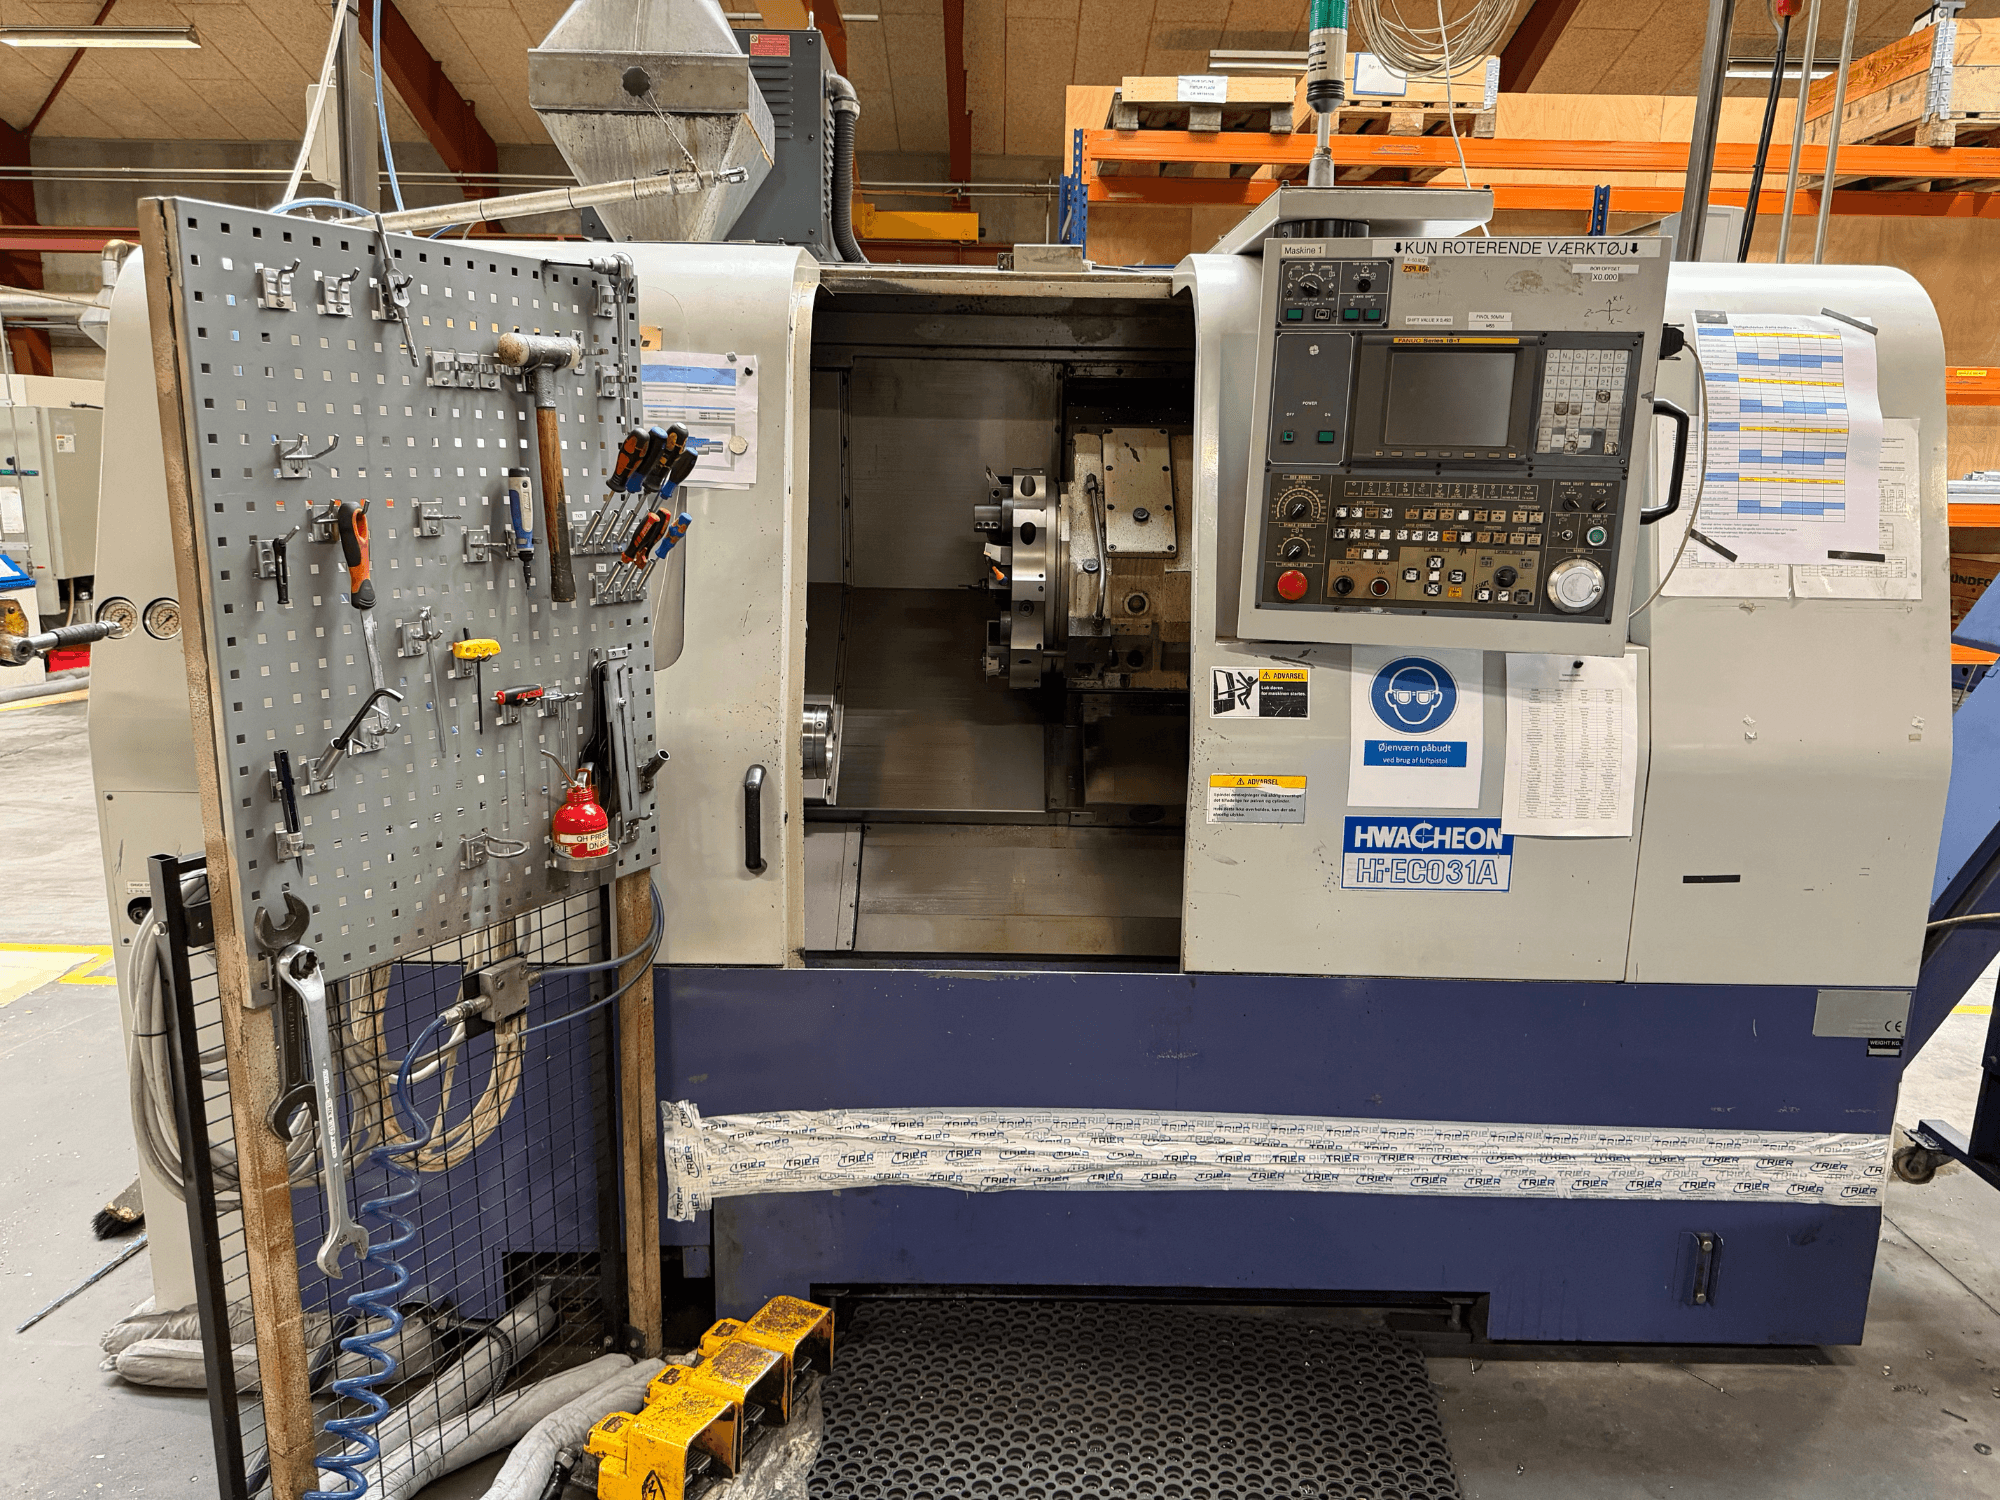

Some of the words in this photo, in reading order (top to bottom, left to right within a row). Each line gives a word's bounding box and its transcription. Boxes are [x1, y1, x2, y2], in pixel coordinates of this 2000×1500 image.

[1285, 247, 1316, 255] Maskine
[1405, 241, 1438, 254] KUN
[1443, 241, 1542, 255] ROTERENDE
[1548, 241, 1628, 255] VÆRKTØJ
[1593, 273, 1618, 281] X0.000
[1273, 672, 1305, 680] ADVARSEL
[1378, 742, 1420, 754] Øjenværn
[1421, 742, 1452, 754] påbudt
[1382, 756, 1394, 764] ved
[1396, 756, 1411, 765] brug
[1411, 756, 1419, 764] af
[1419, 756, 1448, 765] luftpistol
[1354, 821, 1503, 850] HWACHEON
[1162, 1123, 1195, 1133] TRIER
[1217, 1124, 1250, 1134] TRIER
[1271, 1126, 1305, 1136] TRIER
[1327, 1128, 1360, 1138] TRIER
[1382, 1130, 1415, 1140] TRIER
[1437, 1132, 1470, 1142] TRIER
[1491, 1134, 1525, 1144] TRIER
[1546, 1136, 1579, 1145] TRIER
[1600, 1138, 1633, 1147] TRIER
[1709, 1141, 1742, 1151] TRIER
[841, 1153, 874, 1164] TRIER
[894, 1150, 927, 1160] TRIER
[950, 1149, 982, 1158] TRIER
[1326, 1153, 1360, 1163] TRIER
[1381, 1153, 1415, 1162] TRIER
[787, 1157, 820, 1169] TRIER
[1218, 1154, 1251, 1164] TRIER
[1272, 1154, 1306, 1164] TRIER
[1761, 1157, 1794, 1168] TRIER
[1815, 1161, 1848, 1172] TRIER
[984, 1175, 1017, 1185] TRIER
[1251, 1171, 1285, 1181] TRIER
[1306, 1172, 1340, 1182] TRIER
[1360, 1174, 1394, 1184] TRIER
[1414, 1175, 1448, 1185] TRIER
[1469, 1176, 1502, 1186] TRIER
[1522, 1177, 1556, 1188] TRIER
[1576, 1178, 1609, 1189] TRIER
[1630, 1179, 1663, 1189] TRIER
[1683, 1180, 1716, 1190] TRIER
[1737, 1181, 1770, 1191] TRIER
[1792, 1183, 1825, 1194] TRIER
[1845, 1185, 1878, 1196] TRIER
